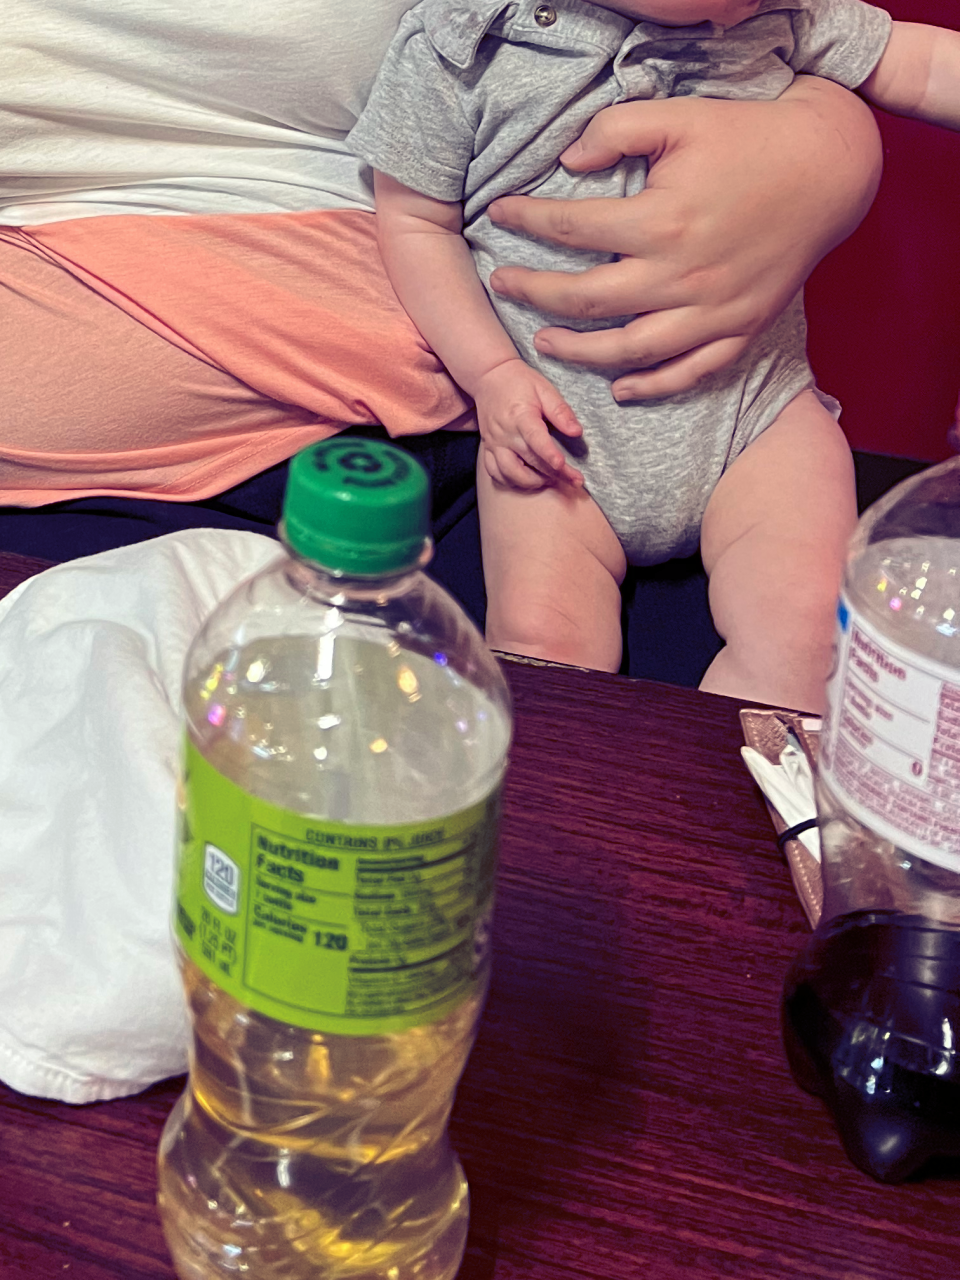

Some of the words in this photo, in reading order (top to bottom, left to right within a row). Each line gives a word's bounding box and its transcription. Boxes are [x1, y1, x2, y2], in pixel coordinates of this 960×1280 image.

[208, 851, 234, 887] 120
[255, 852, 304, 882] Facts
[257, 834, 339, 871] Nutrition
[315, 930, 348, 951] 120
